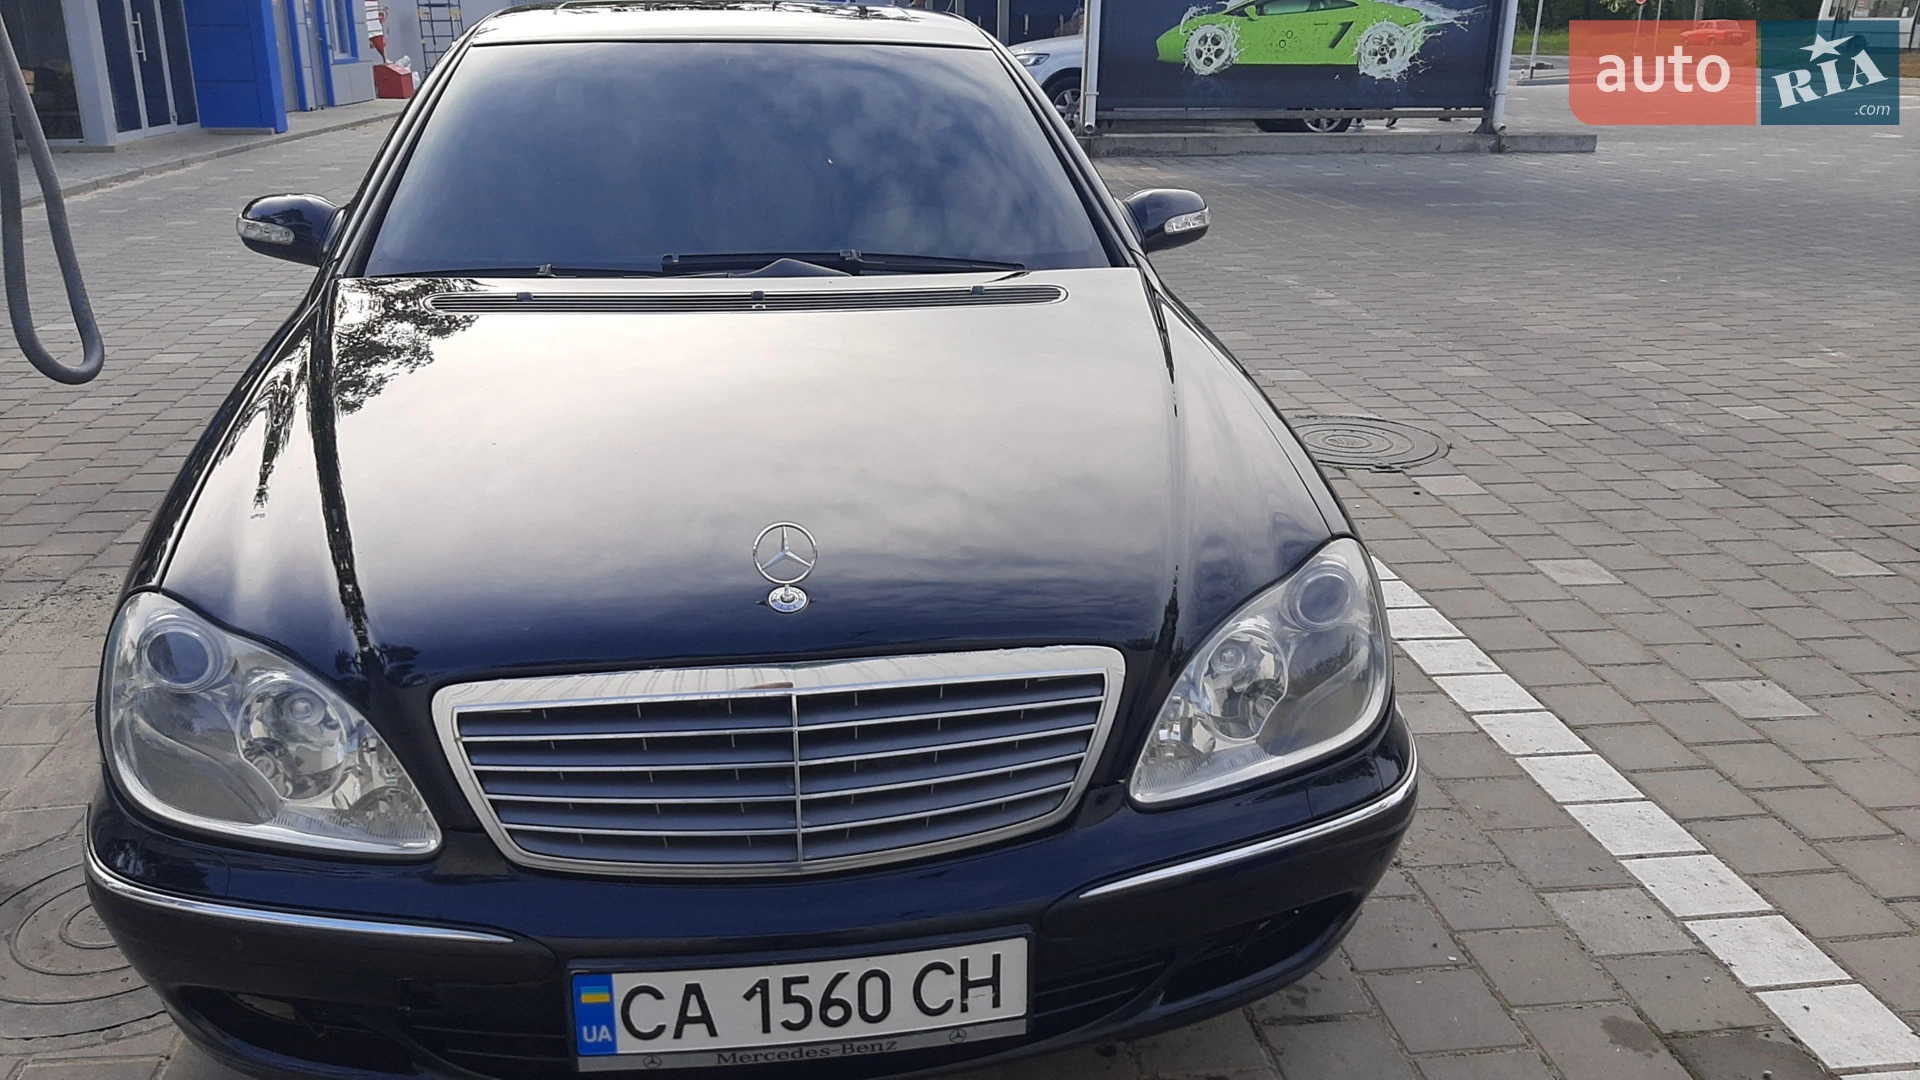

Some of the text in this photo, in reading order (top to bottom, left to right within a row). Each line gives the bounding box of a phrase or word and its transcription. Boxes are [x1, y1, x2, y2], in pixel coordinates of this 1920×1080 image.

[620, 953, 1002, 1041] CA 1560 CH
[583, 1025, 612, 1043] UA
[716, 1040, 898, 1066] Mercedes-Benz
